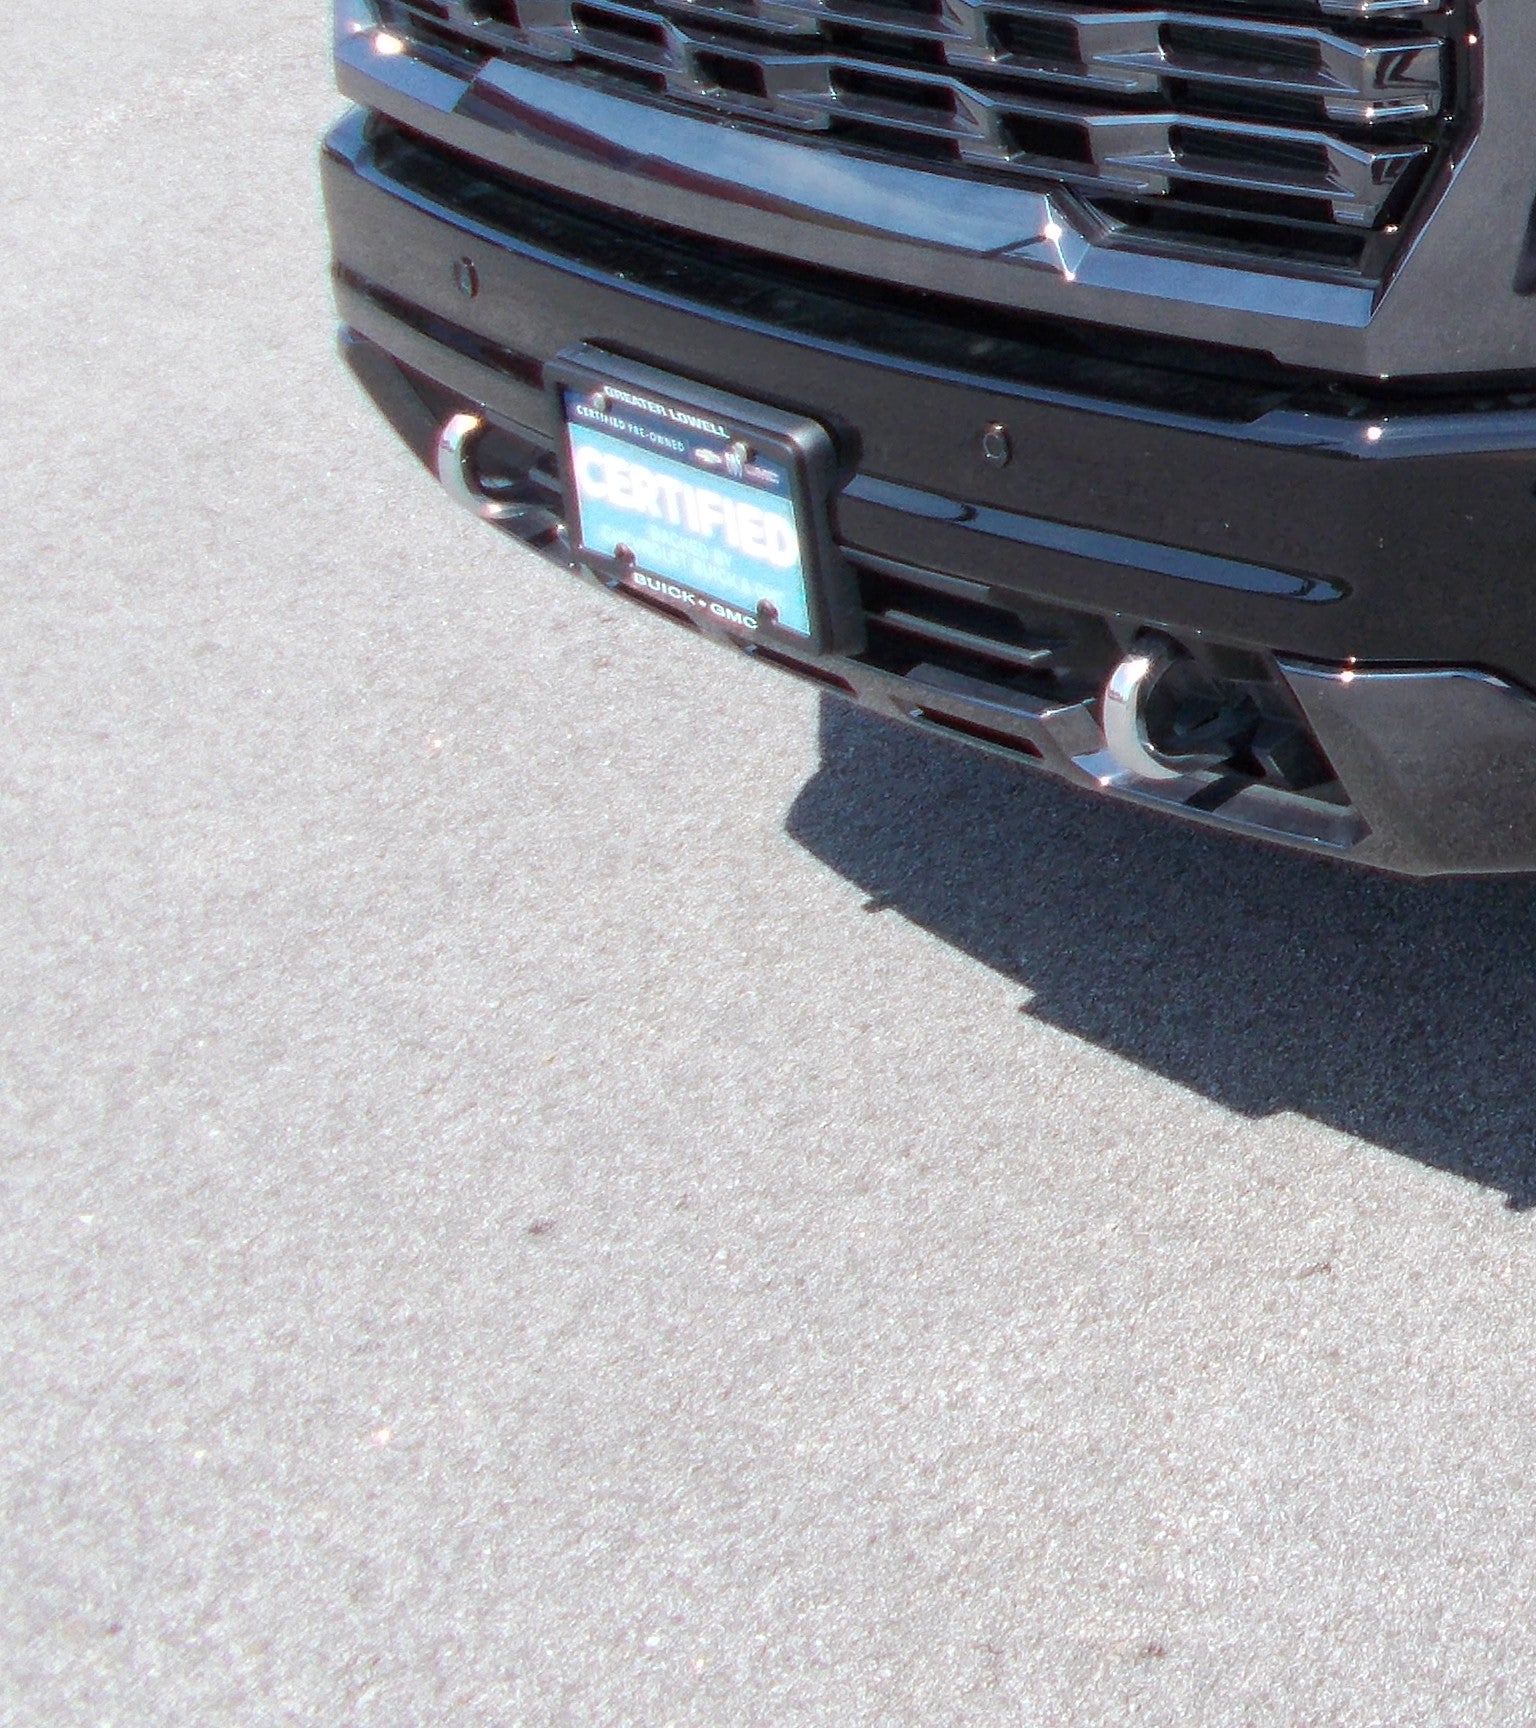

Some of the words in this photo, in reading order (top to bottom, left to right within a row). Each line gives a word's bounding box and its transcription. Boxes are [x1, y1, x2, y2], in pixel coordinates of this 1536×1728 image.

[603, 385, 668, 417] GREATER
[668, 408, 731, 440] LOWELL
[573, 446, 801, 569] CERTIFIED
[633, 572, 696, 605] BUICK
[709, 603, 759, 630] GMC
